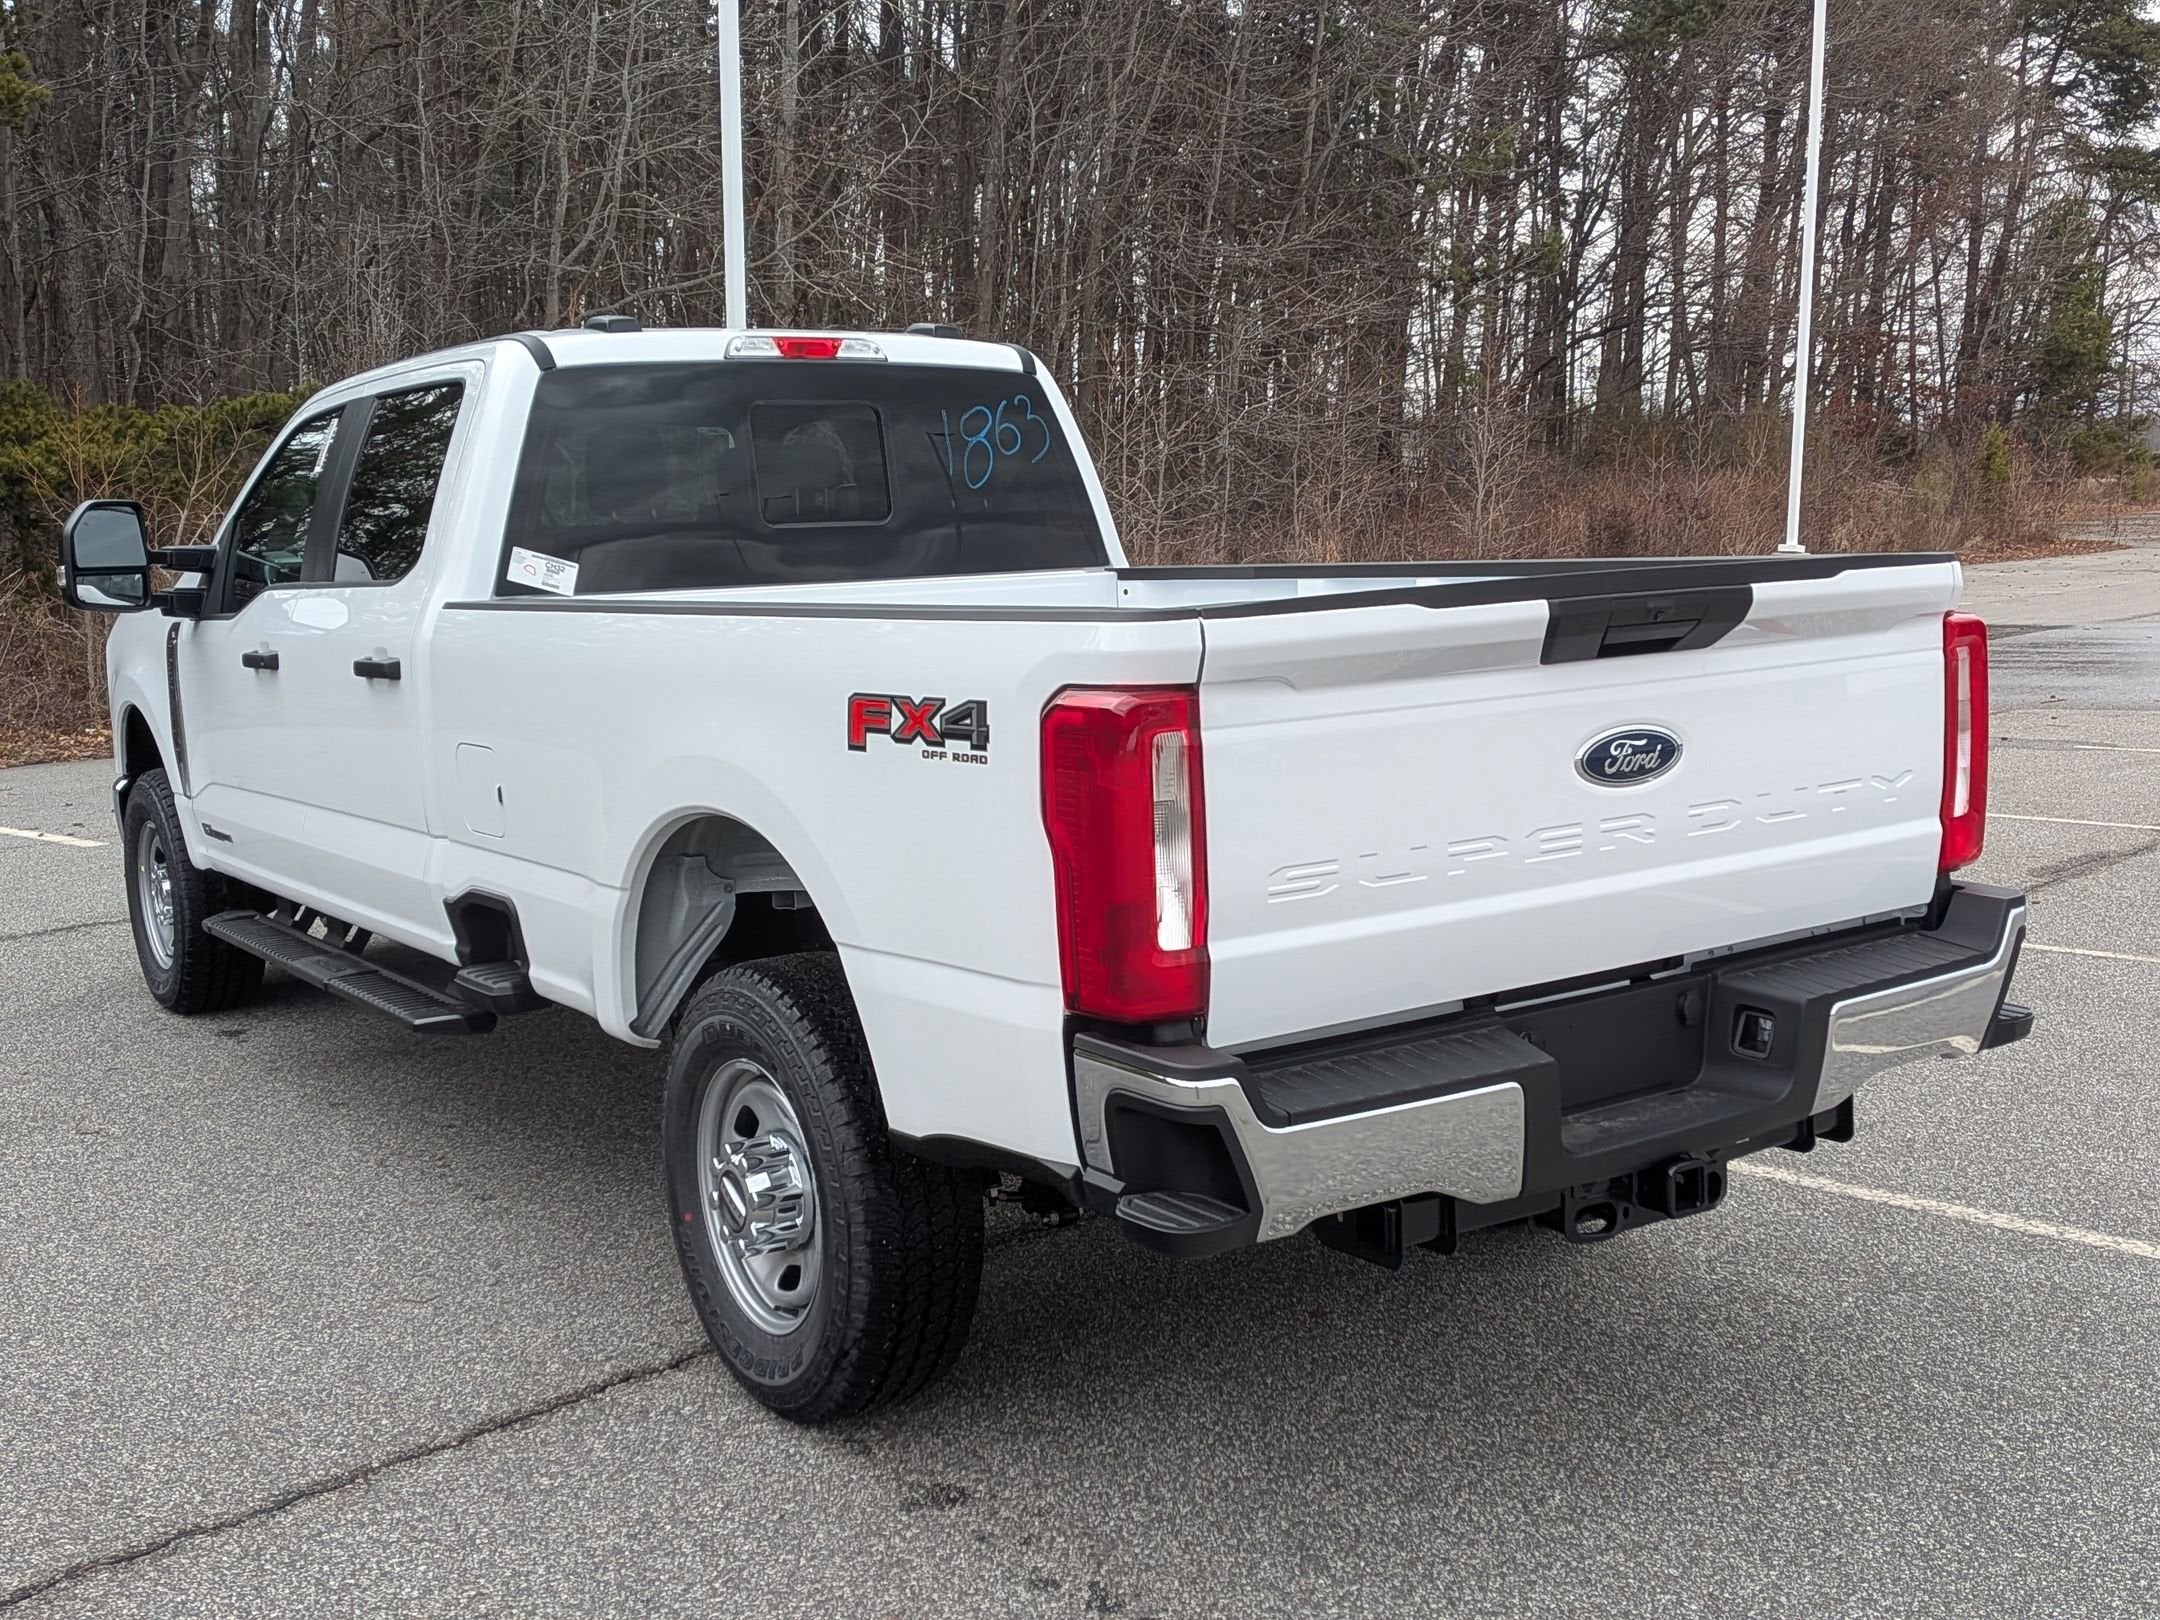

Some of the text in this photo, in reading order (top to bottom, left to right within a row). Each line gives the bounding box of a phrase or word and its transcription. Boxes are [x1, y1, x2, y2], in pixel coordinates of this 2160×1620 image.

[941, 394, 1050, 489] 1863
[847, 692, 990, 752] FX4
[921, 749, 988, 765] OFF ROAD
[1604, 738, 1662, 774] Ford
[1268, 769, 1913, 903] SUPER DUTY
